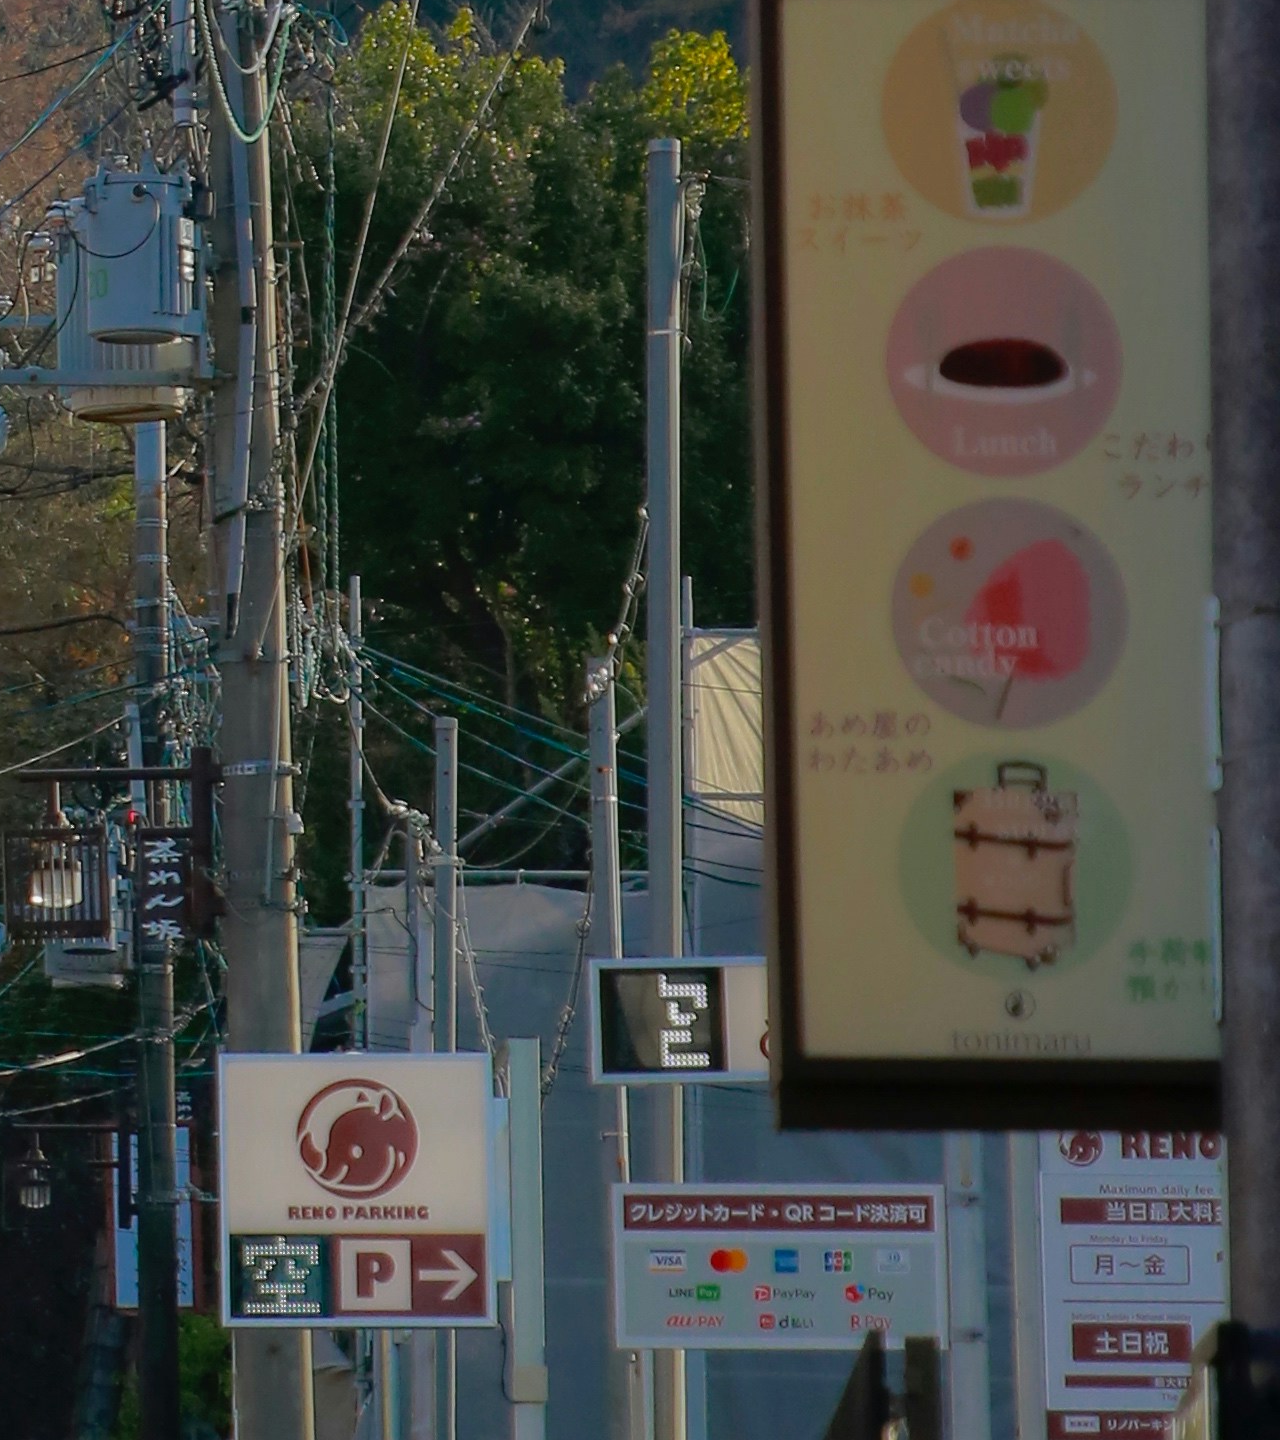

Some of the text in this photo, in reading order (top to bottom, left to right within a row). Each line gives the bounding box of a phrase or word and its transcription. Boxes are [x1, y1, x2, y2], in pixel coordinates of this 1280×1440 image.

[953, 427, 1058, 458] Lunch
[920, 617, 1039, 648] Cotton
[914, 652, 1019, 682] candy
[142, 836, 183, 940] 茶わん坂
[952, 1028, 1092, 1055] tonimaru
[1099, 1184, 1214, 1198] Maximum daily fee
[287, 1205, 429, 1220] RENO PARKING
[242, 1235, 321, 1314] 空
[655, 1255, 683, 1267] VISA
[355, 1252, 396, 1299] P
[668, 1288, 694, 1299] LINE
[773, 1287, 816, 1302] PayPay
[868, 1286, 894, 1303] Pay
[697, 1316, 725, 1328] PAY
[1096, 1330, 1169, 1355] 土日祝
